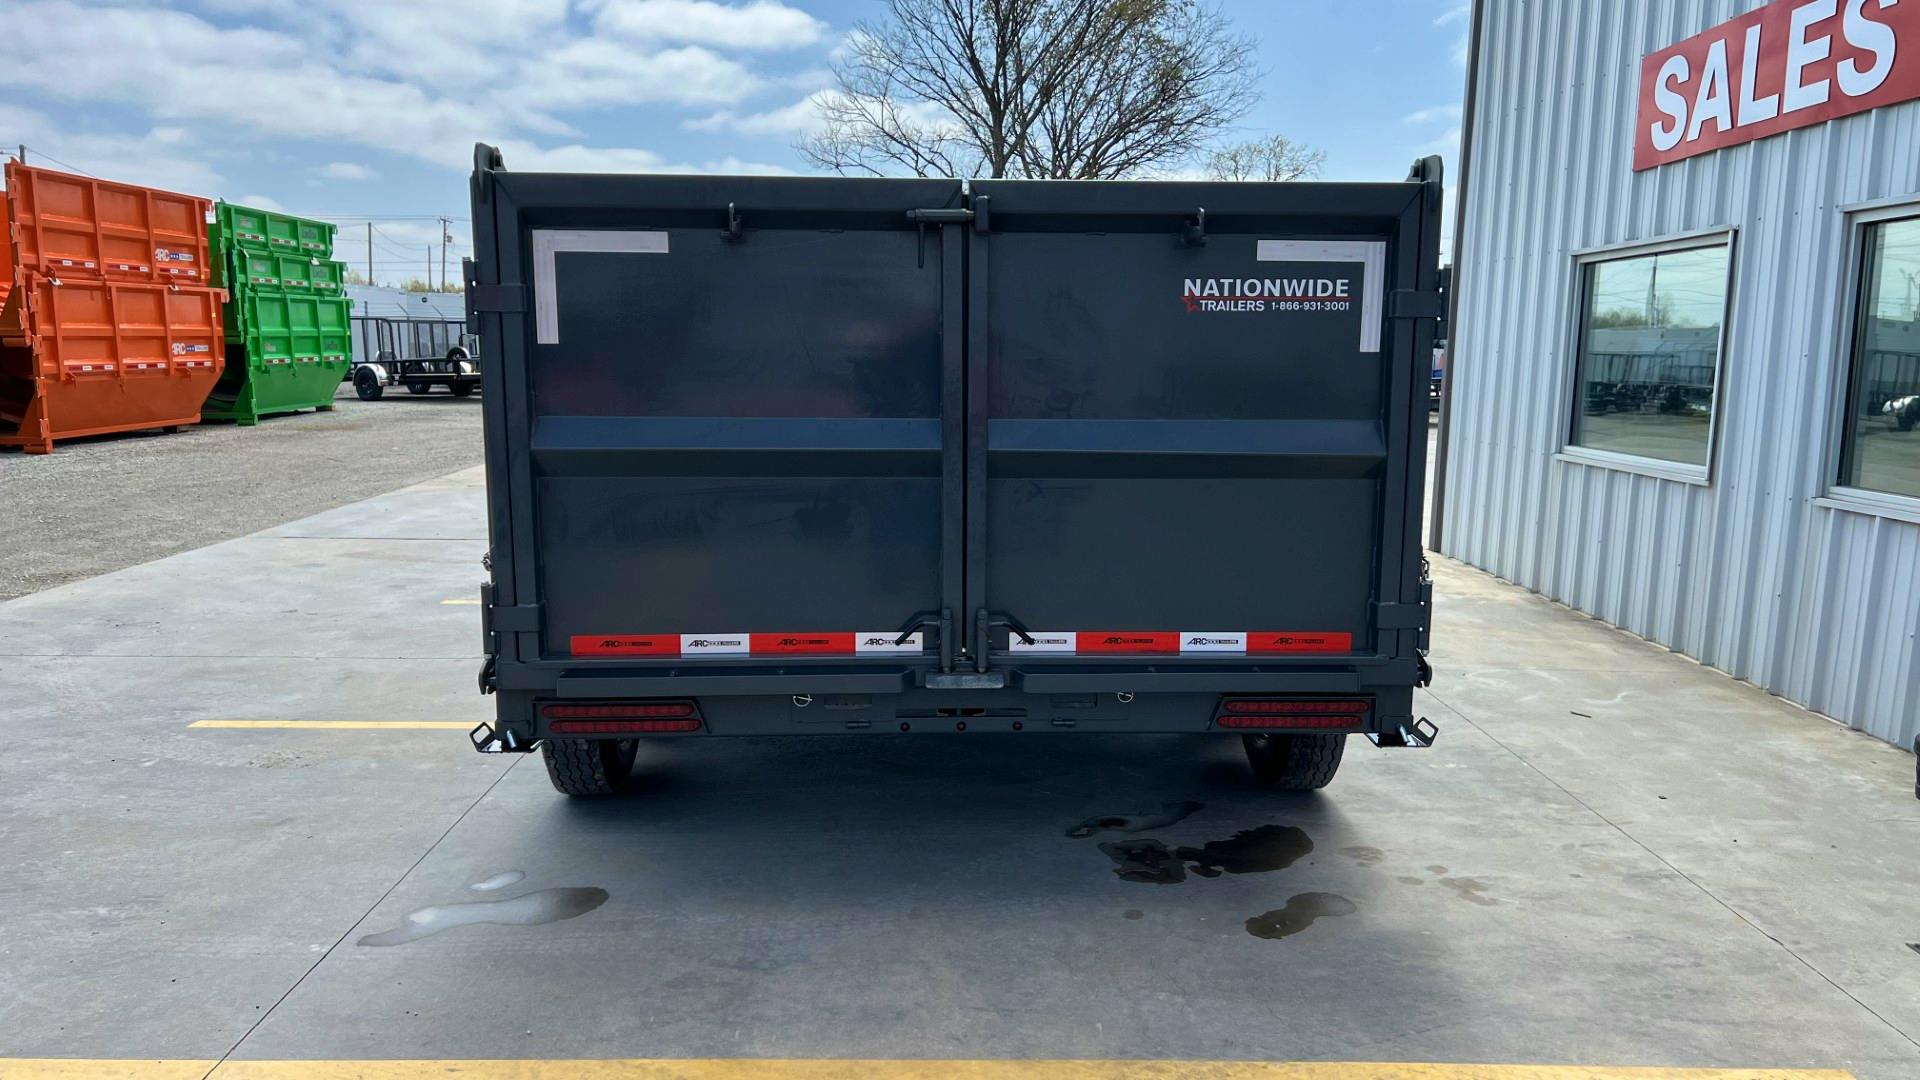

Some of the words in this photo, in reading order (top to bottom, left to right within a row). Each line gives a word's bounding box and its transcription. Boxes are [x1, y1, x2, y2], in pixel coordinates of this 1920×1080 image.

[1651, 0, 1898, 151] SALES
[1184, 279, 1349, 297] NATIONWIDE
[1200, 300, 1265, 311] TRAILERS
[1272, 302, 1349, 311] 1-866-931-3001
[864, 638, 884, 646] ARC
[1187, 637, 1207, 645] ARC
